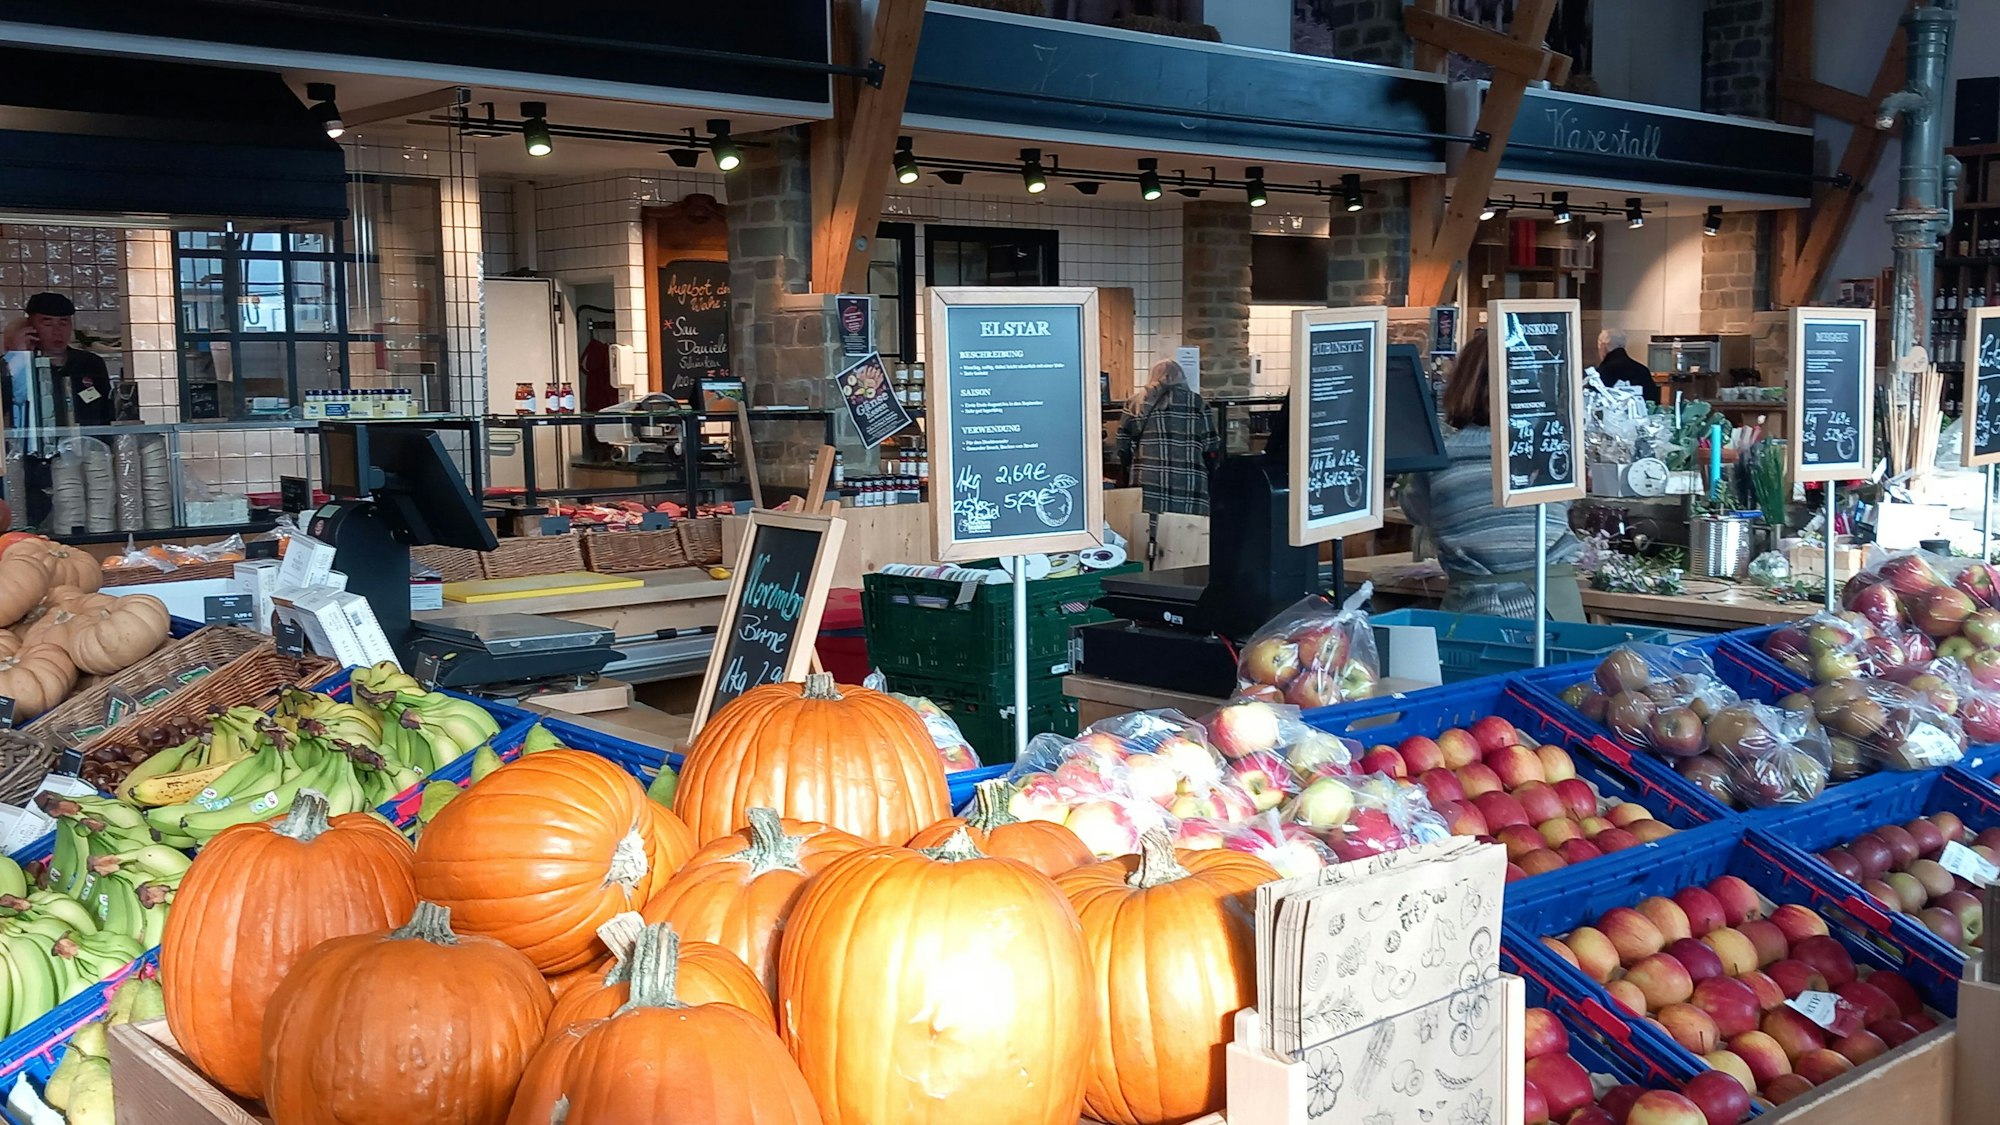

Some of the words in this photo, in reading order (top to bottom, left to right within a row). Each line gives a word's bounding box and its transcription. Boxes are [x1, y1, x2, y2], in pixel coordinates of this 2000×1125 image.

[1545, 107, 1661, 159] Käsestall
[980, 321, 1051, 337] ELSTAR
[960, 388, 991, 397] SAISON
[961, 424, 1021, 434] VERWENDUNG
[995, 462, 1051, 485] 2,69€
[738, 615, 788, 654] Birne
